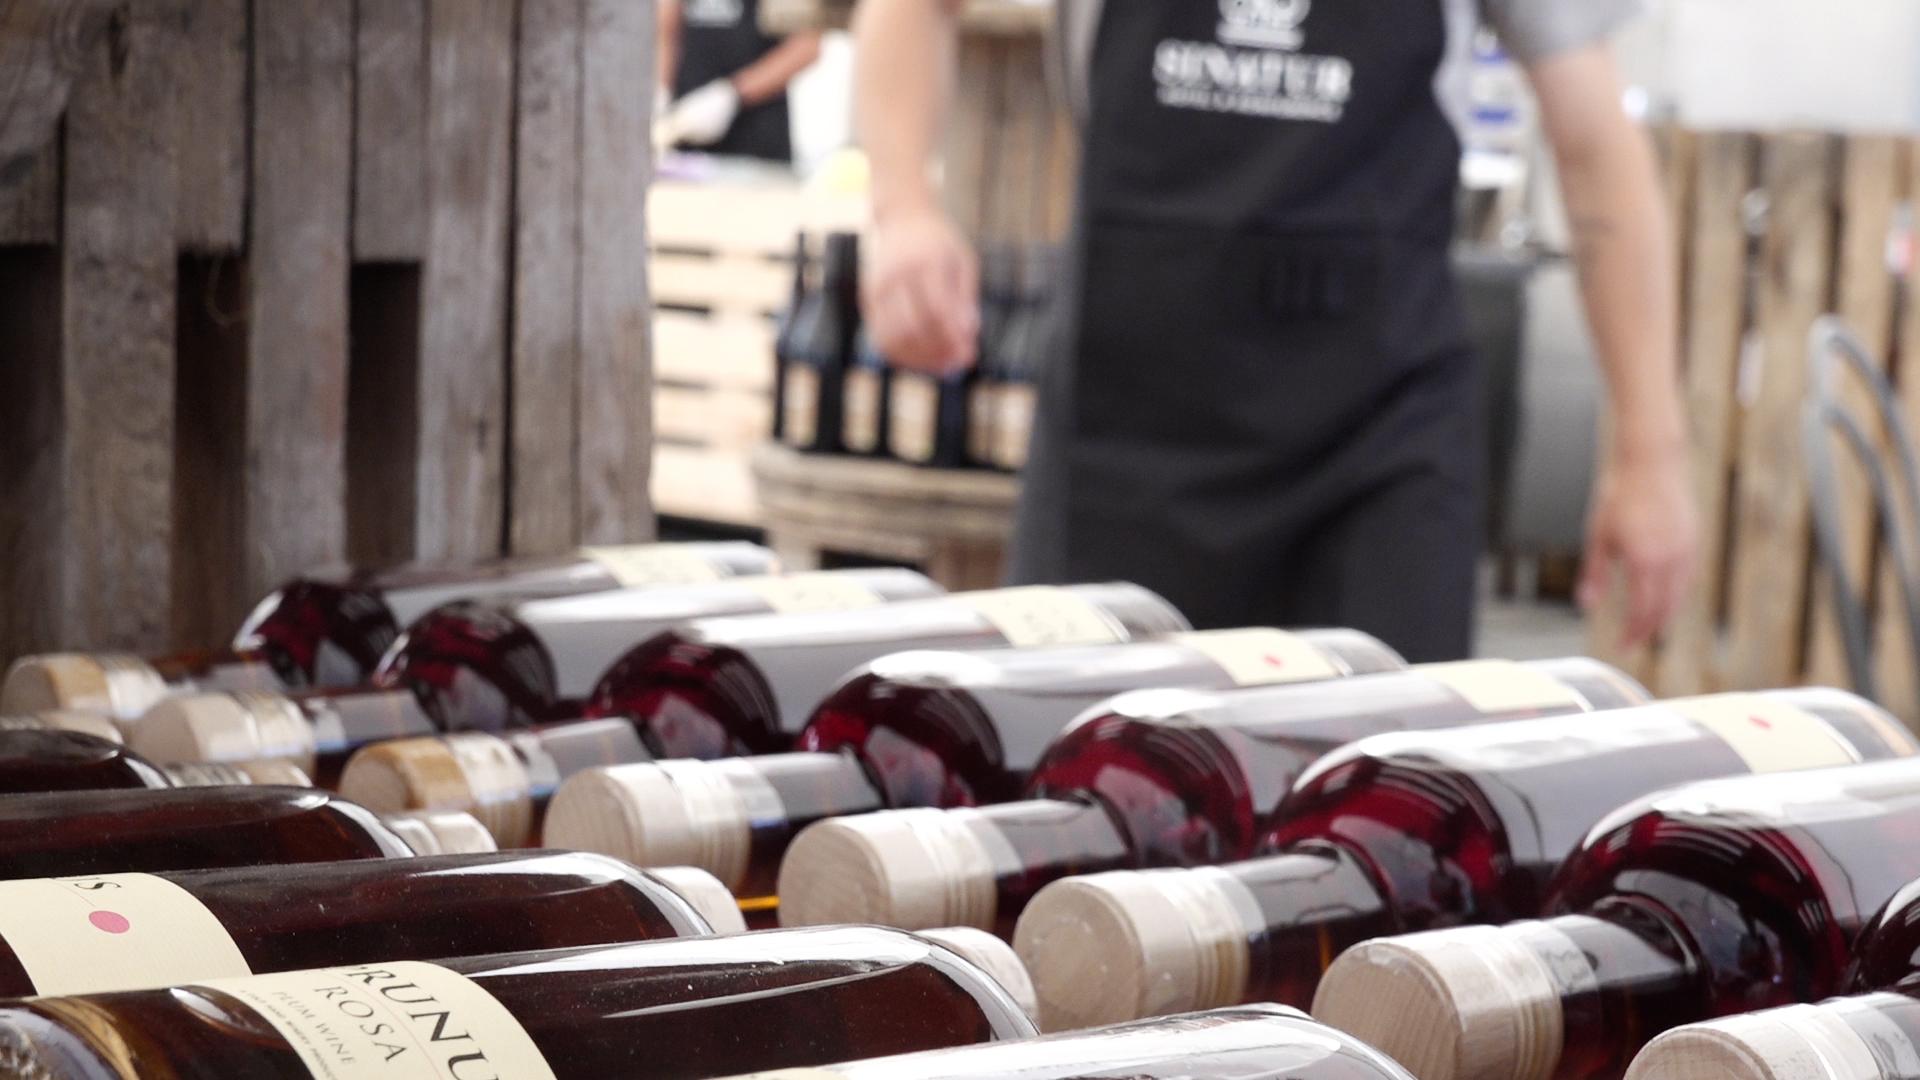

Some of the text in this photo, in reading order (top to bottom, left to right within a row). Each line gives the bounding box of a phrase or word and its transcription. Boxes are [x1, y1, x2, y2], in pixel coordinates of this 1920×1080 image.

[314, 986, 407, 1062] ROSA
[315, 1023, 355, 1064] WINE
[342, 967, 500, 1080] RUNU
